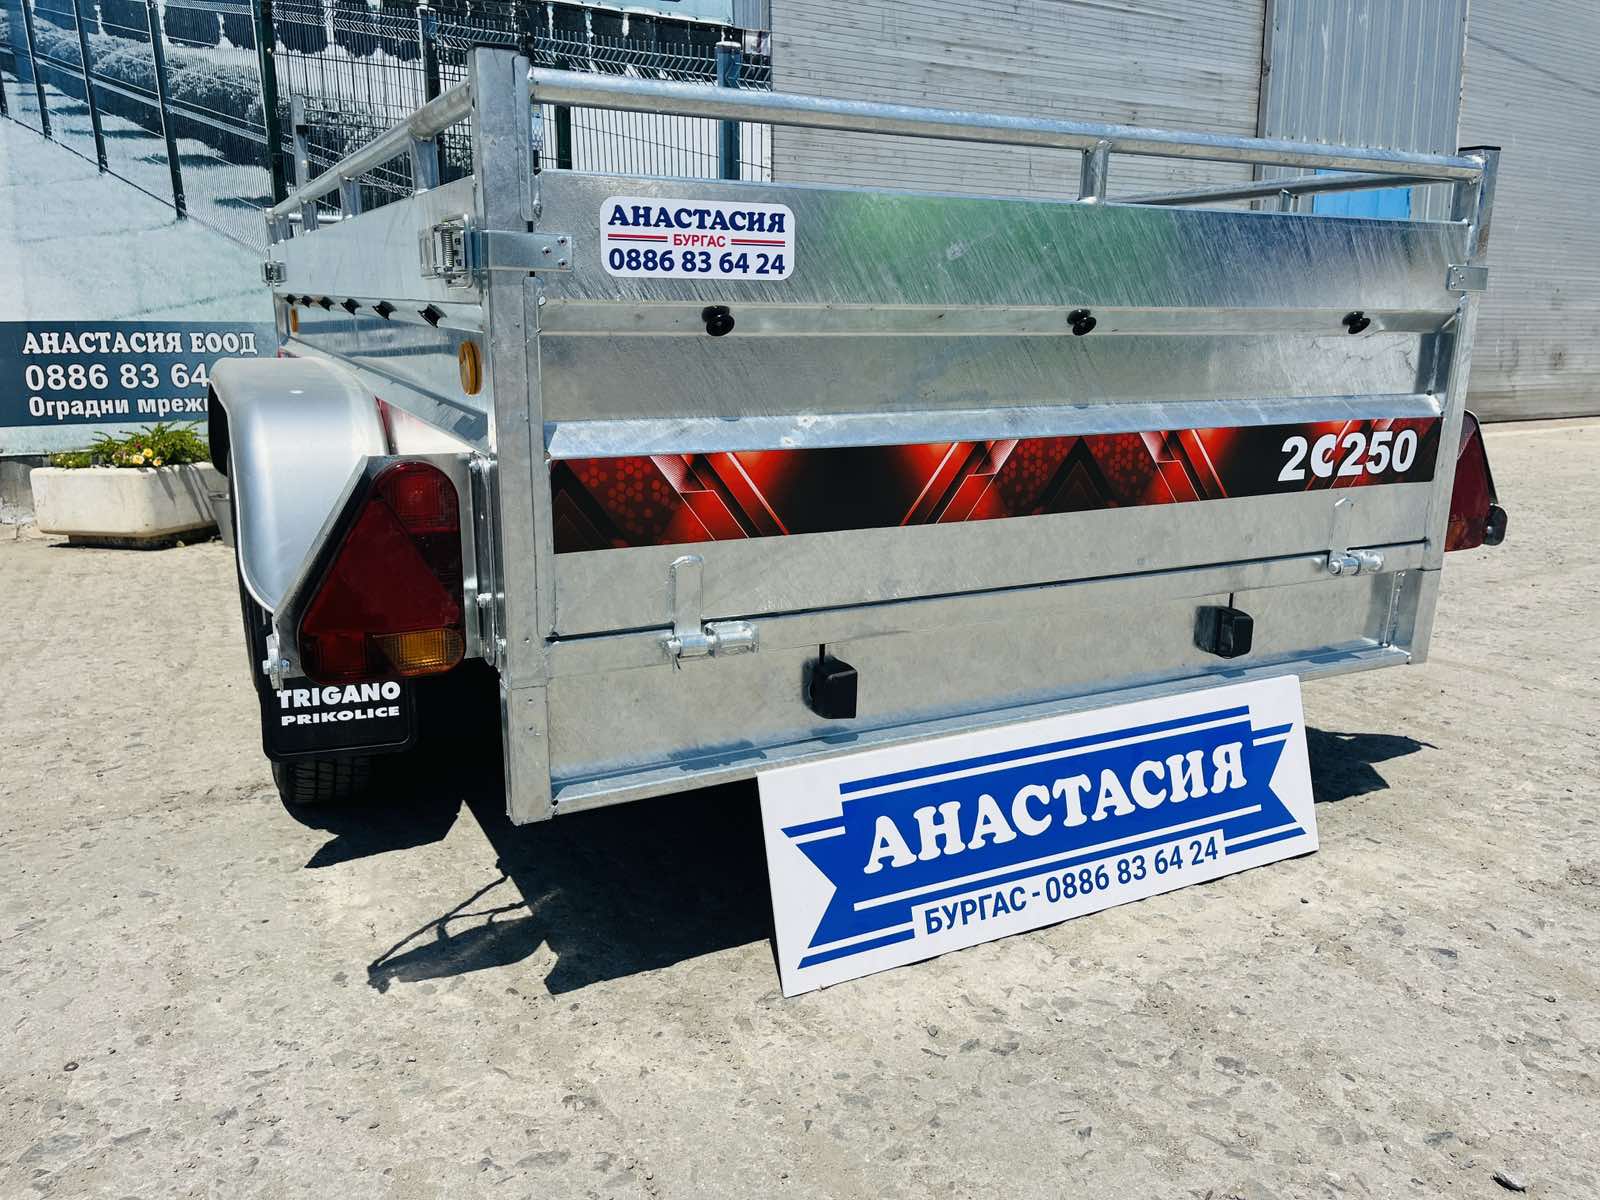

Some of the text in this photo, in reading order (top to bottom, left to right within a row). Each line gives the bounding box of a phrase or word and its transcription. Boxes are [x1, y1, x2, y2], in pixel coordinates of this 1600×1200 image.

[607, 204, 786, 233] АНАСТАСИЯ
[673, 234, 727, 248] БУРГАС
[608, 248, 785, 275] 0886 83 64 24
[22, 332, 258, 355] АНАСТАСИЯ ЕООД
[25, 362, 210, 391] 0886 83 64
[29, 396, 129, 420] Оградни
[276, 681, 401, 709] TRIGANO
[281, 705, 400, 726] PRIKOLICE
[863, 741, 1248, 875] АНАСТАСИЯ
[1045, 864, 1110, 903] 0886
[1117, 854, 1147, 885] 83
[1154, 845, 1183, 875] 64
[1189, 836, 1218, 866] 24
